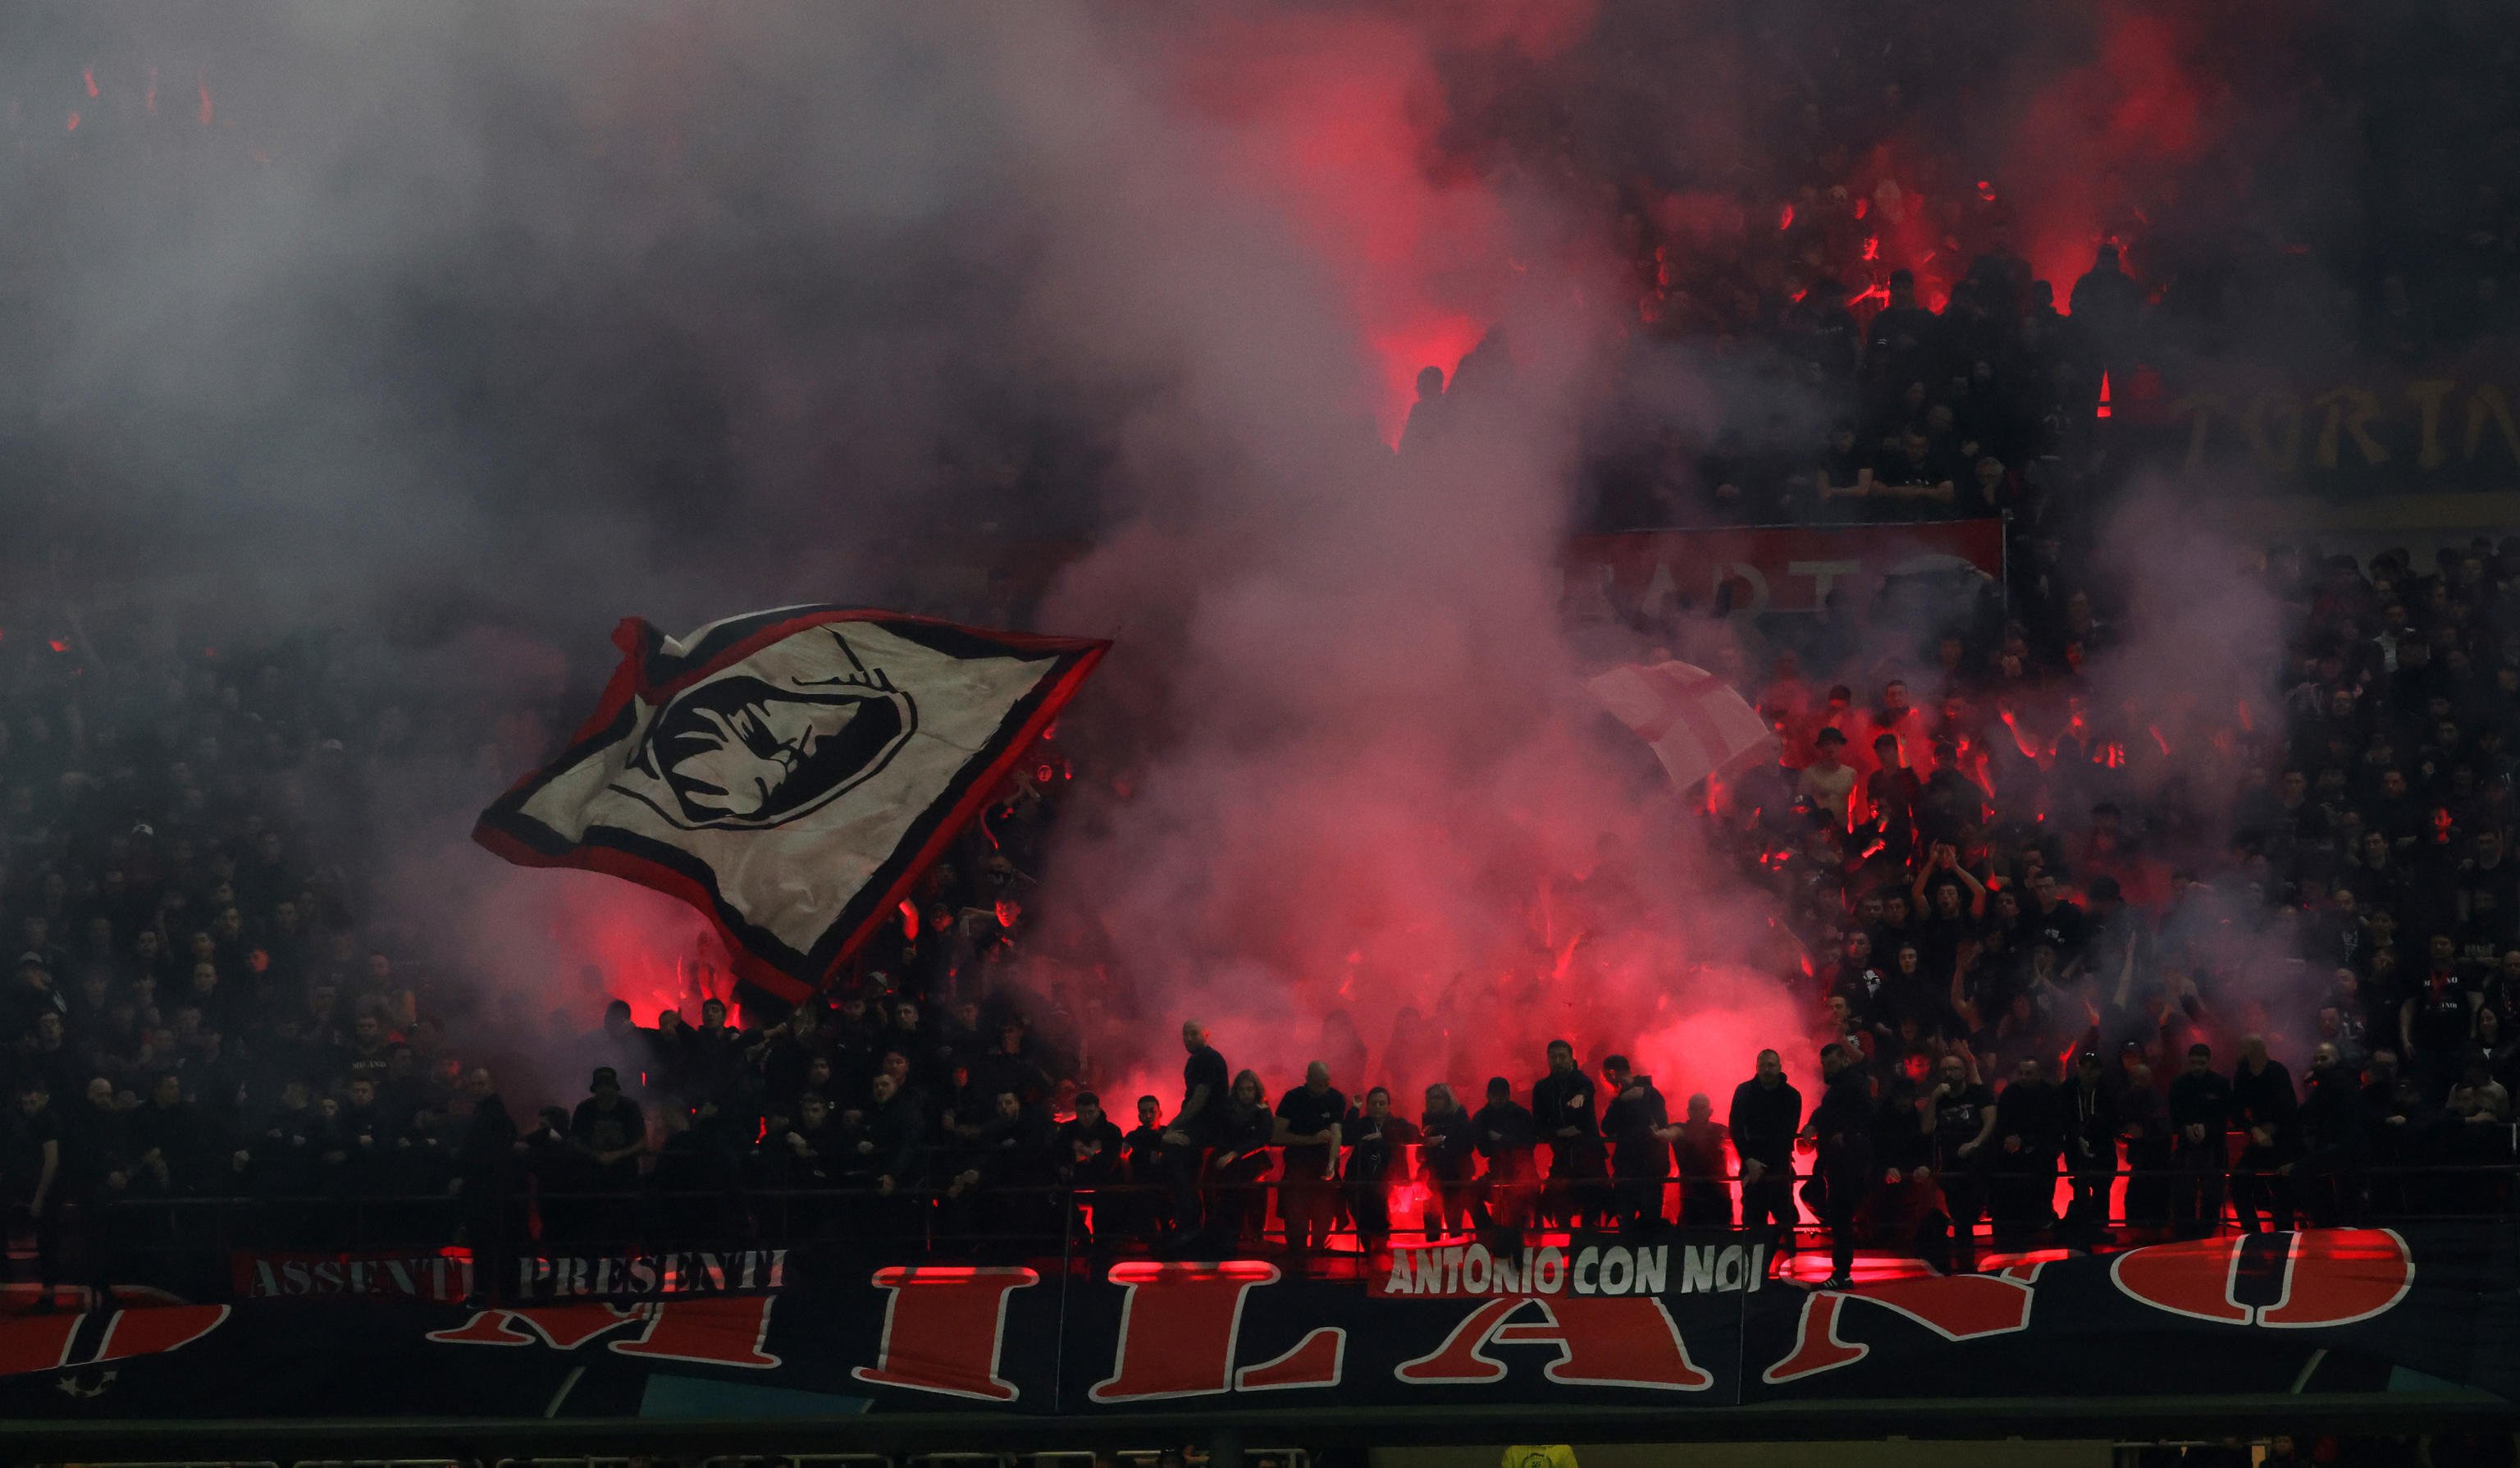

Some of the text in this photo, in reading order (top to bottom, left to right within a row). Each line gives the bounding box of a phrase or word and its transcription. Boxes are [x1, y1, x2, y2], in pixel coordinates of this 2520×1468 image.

[249, 1248, 789, 1301] ASSENTI PRESENTI
[1385, 1242, 1765, 1295] ANTONIO CON NOI
